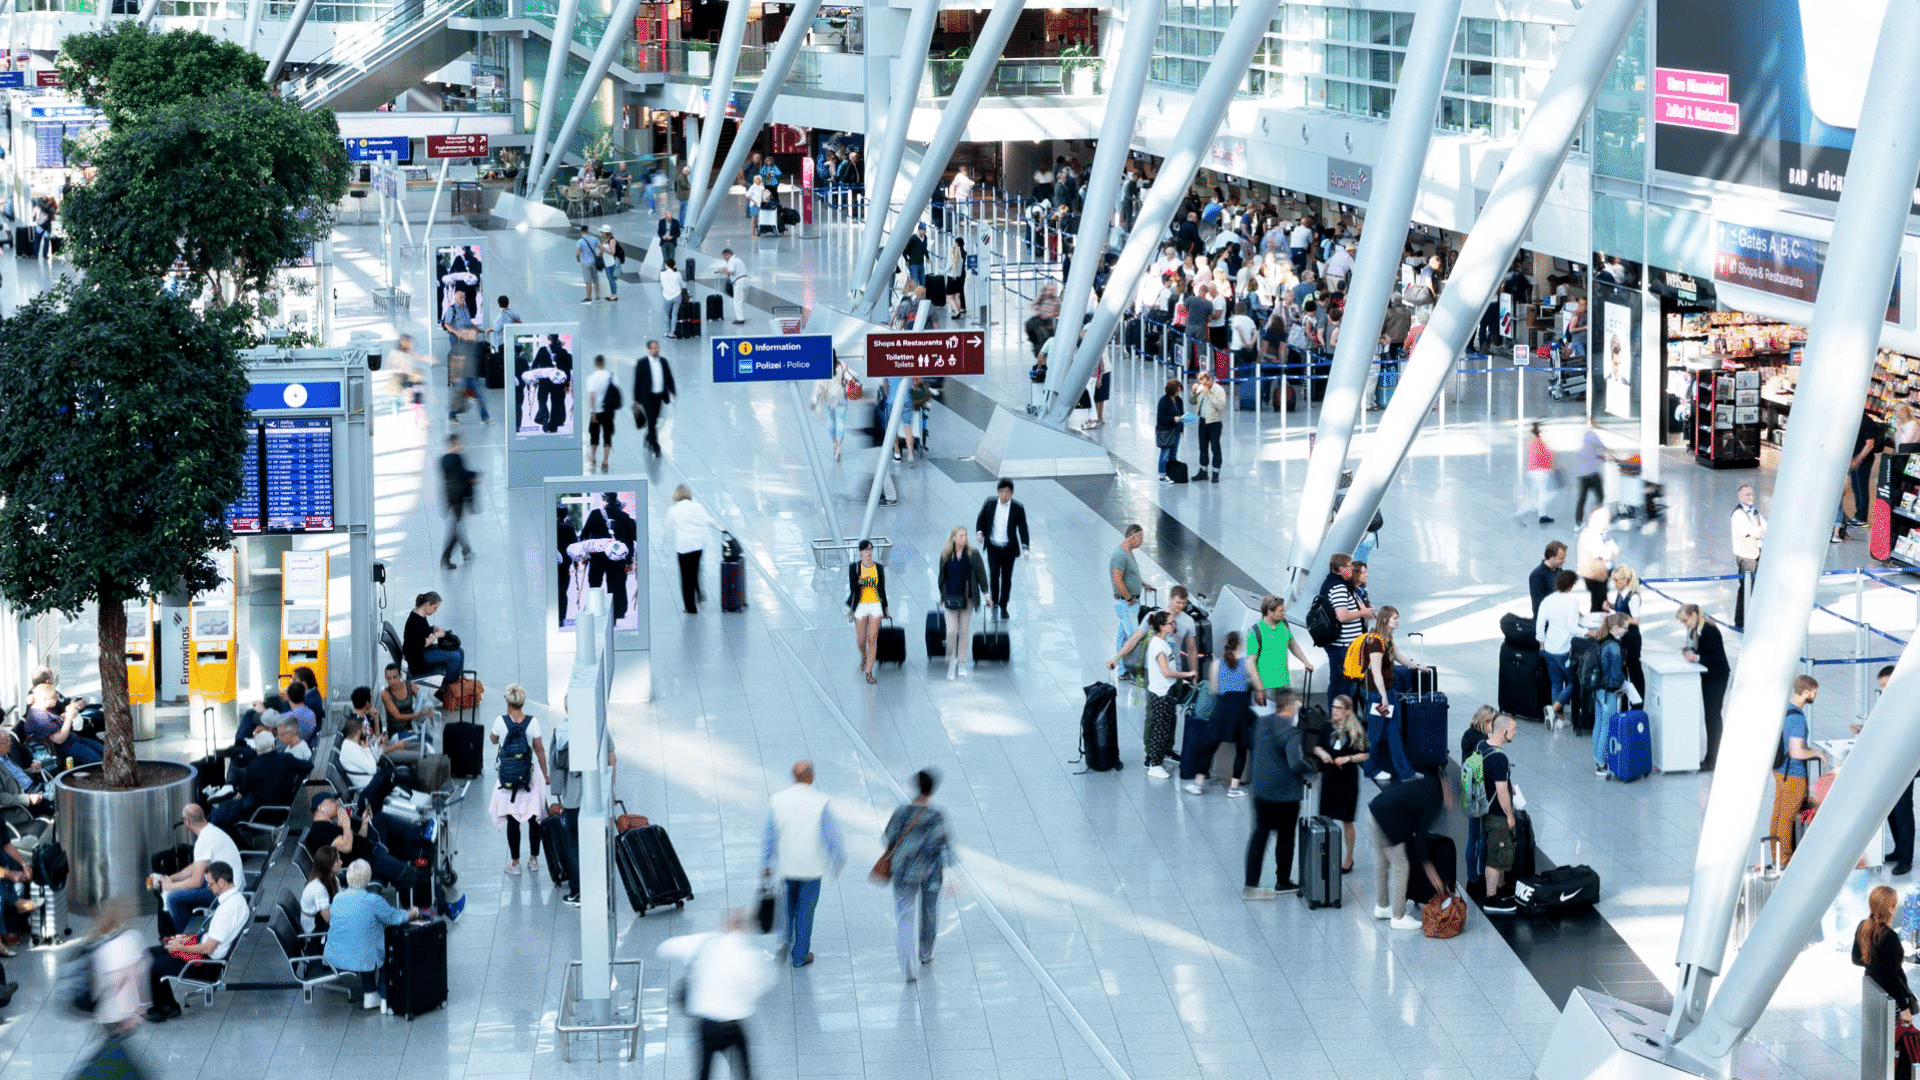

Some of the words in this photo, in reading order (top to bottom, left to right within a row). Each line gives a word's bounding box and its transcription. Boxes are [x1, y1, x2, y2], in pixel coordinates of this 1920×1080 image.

[1330, 172, 1360, 196] Eurowings
[1789, 168, 1808, 186] BAD
[1817, 170, 1845, 192] KÜCH
[1739, 229, 1767, 252] Gates
[1665, 272, 1697, 293] WHSmith
[1738, 262, 1758, 280] Shops
[1758, 267, 1764, 279] &
[1765, 268, 1804, 288] Restaurants
[755, 343, 801, 351] Information
[873, 340, 895, 348] Shops
[903, 339, 943, 347] Restaurants
[755, 361, 782, 369] Polizei
[786, 361, 810, 369] Police
[181, 626, 189, 685] Eurowings
